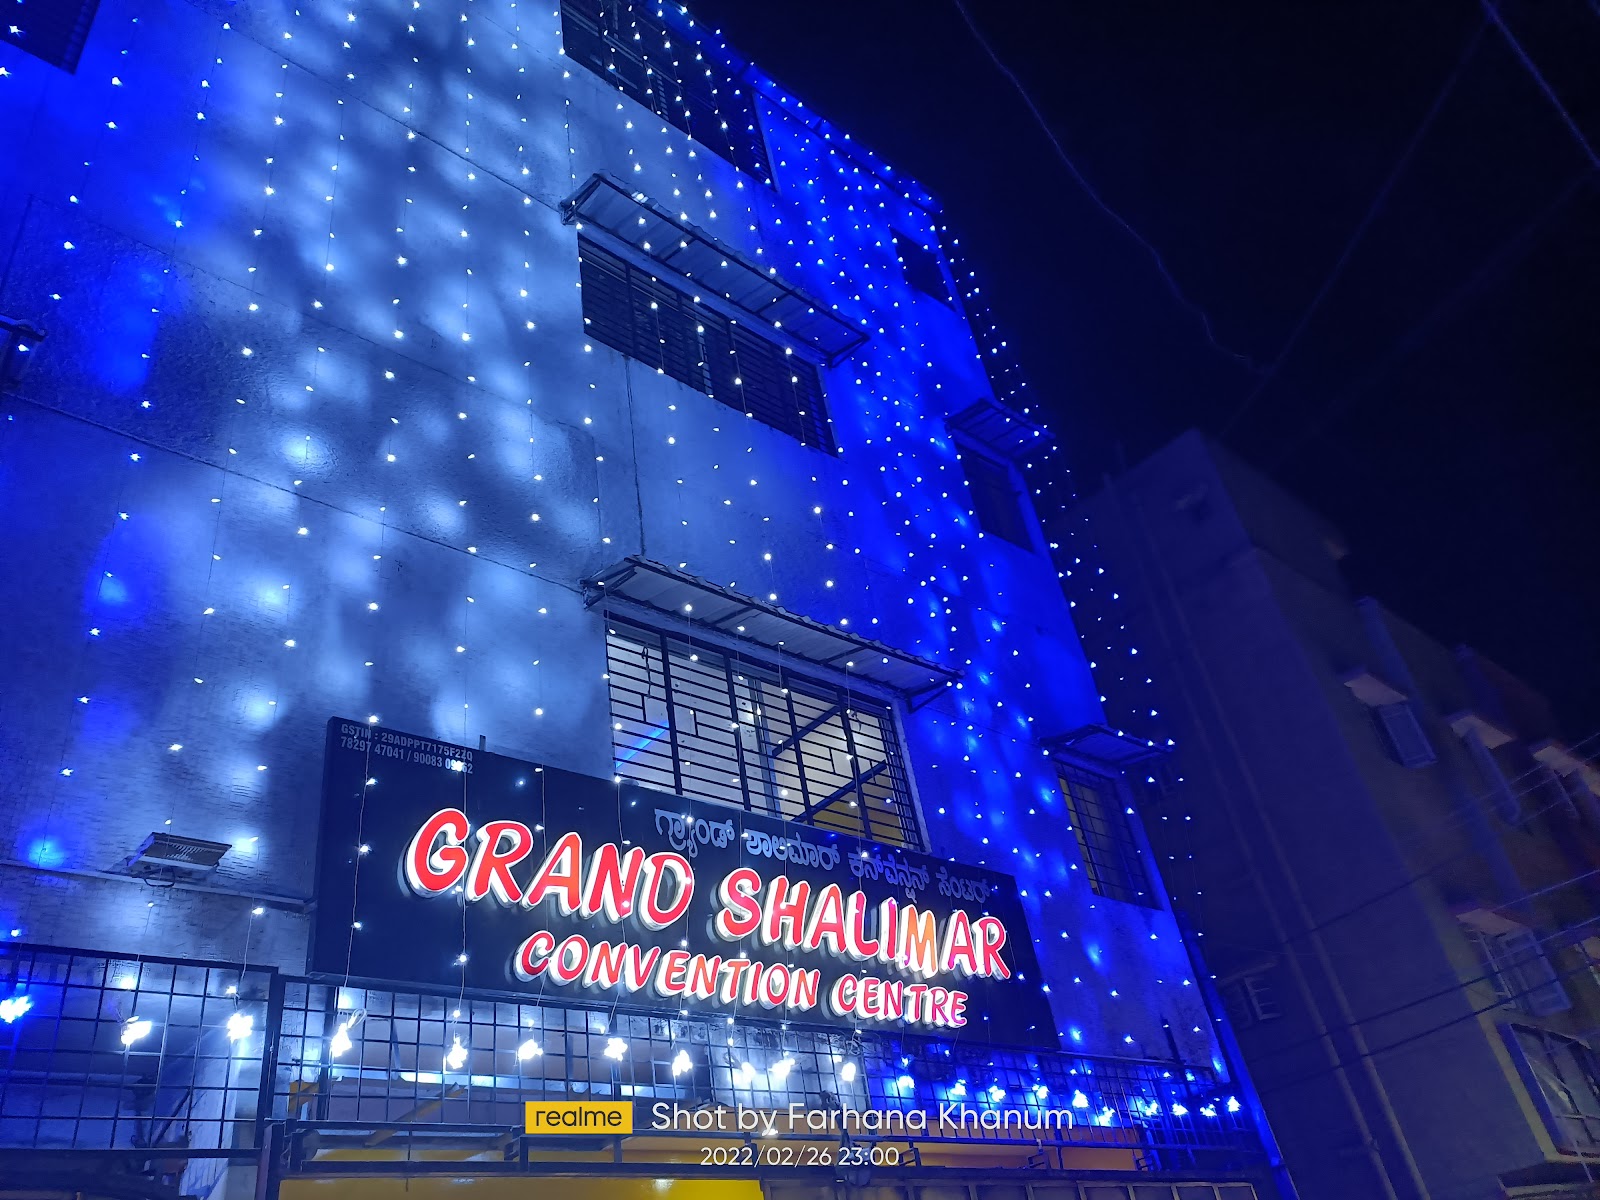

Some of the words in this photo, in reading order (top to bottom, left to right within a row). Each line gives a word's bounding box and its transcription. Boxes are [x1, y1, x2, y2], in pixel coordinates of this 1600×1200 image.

[341, 723, 371, 739] GSTIN
[341, 736, 371, 753] 78297
[374, 746, 404, 760] 47041
[413, 751, 442, 768] 90083
[445, 758, 473, 775] 0962
[405, 807, 695, 932] GRAND
[716, 866, 1011, 981] SHALIMAR
[515, 930, 821, 1012] CONVENTION
[831, 973, 968, 1029] CENTRE
